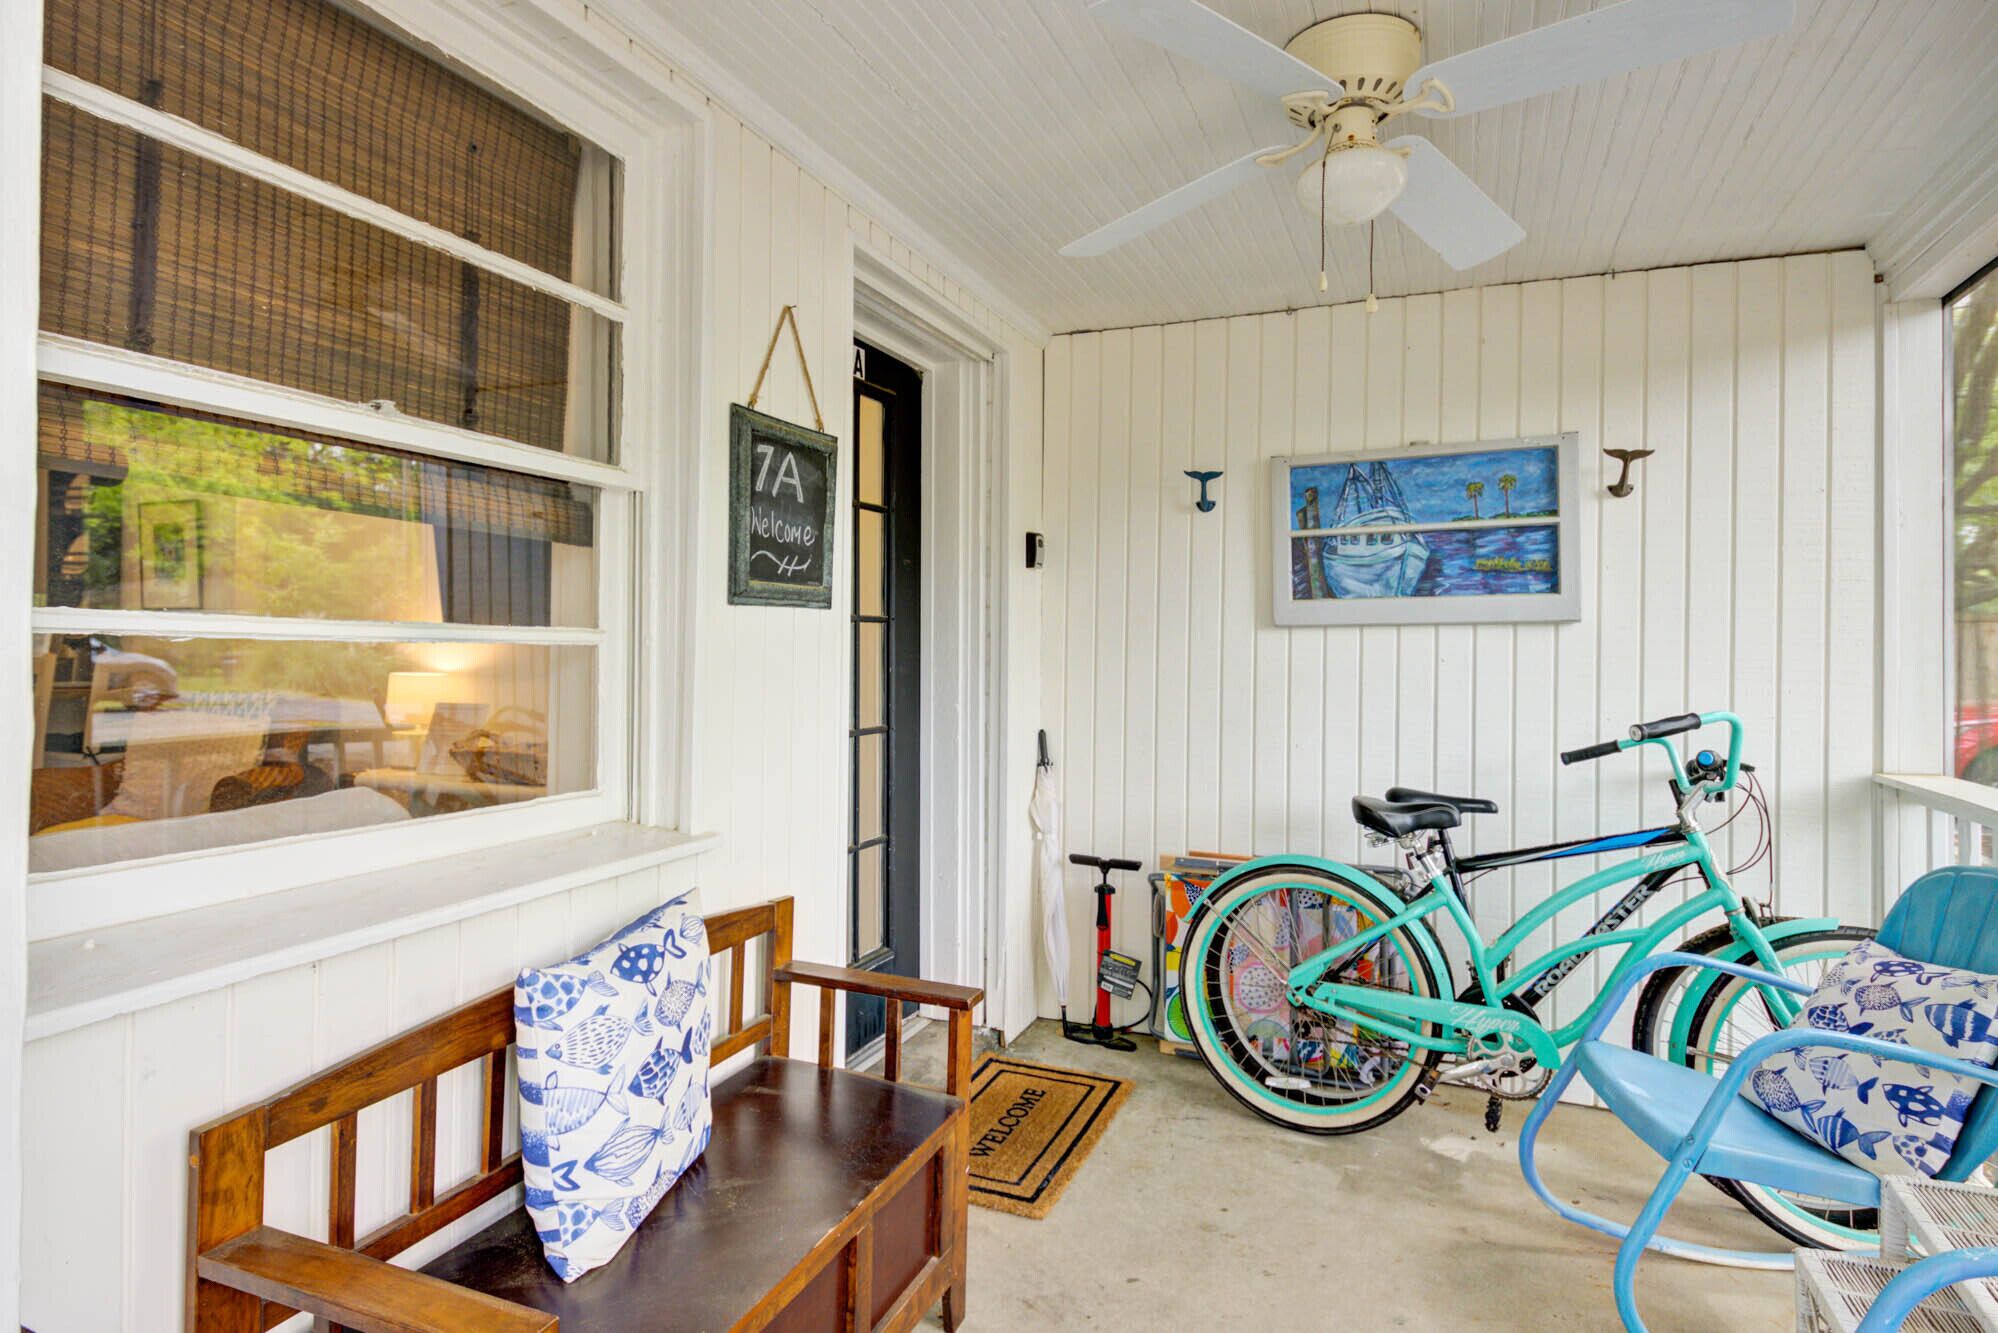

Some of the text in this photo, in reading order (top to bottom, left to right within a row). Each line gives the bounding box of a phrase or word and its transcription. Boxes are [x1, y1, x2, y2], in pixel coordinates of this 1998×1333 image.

[853, 349, 863, 378] A
[755, 444, 804, 504] 7A
[751, 507, 816, 546] Welcome
[1534, 884, 1654, 997] ROADASTER
[969, 1088, 1047, 1157] WELCOME
